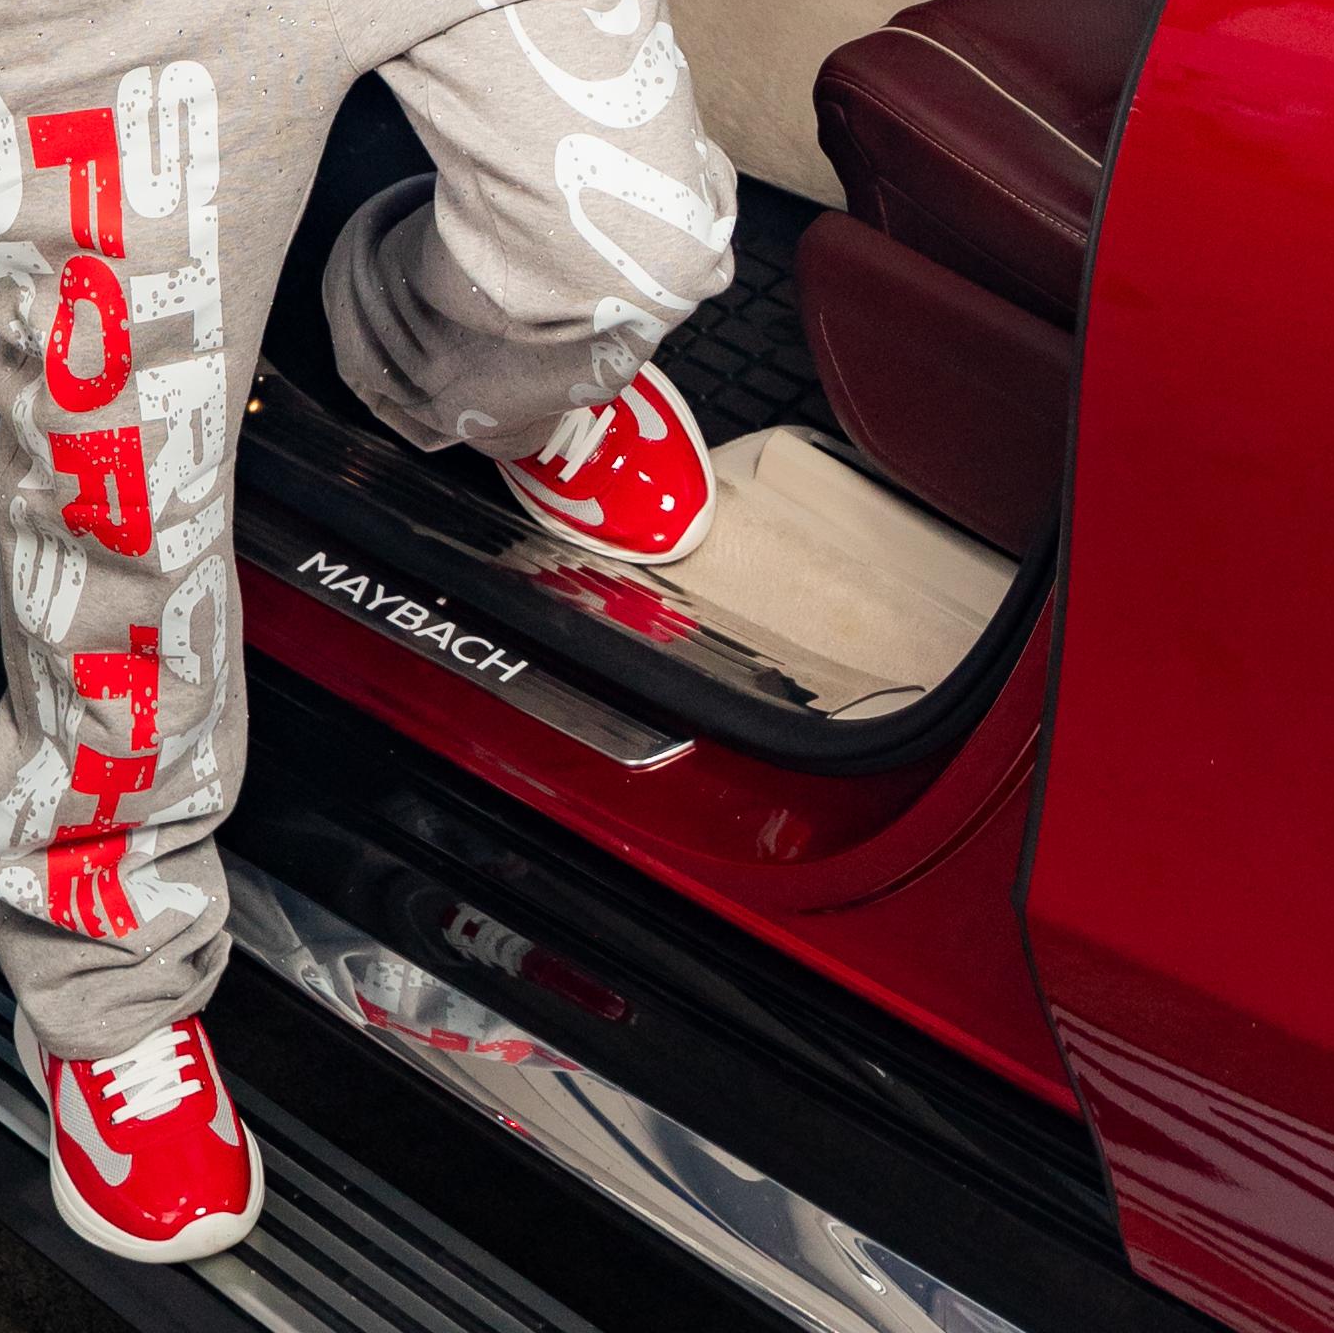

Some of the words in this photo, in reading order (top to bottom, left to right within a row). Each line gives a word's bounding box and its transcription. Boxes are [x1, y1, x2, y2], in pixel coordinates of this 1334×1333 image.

[27, 107, 153, 558] FOR
[296, 551, 530, 683] MAYBACH
[47, 623, 159, 939] THE
